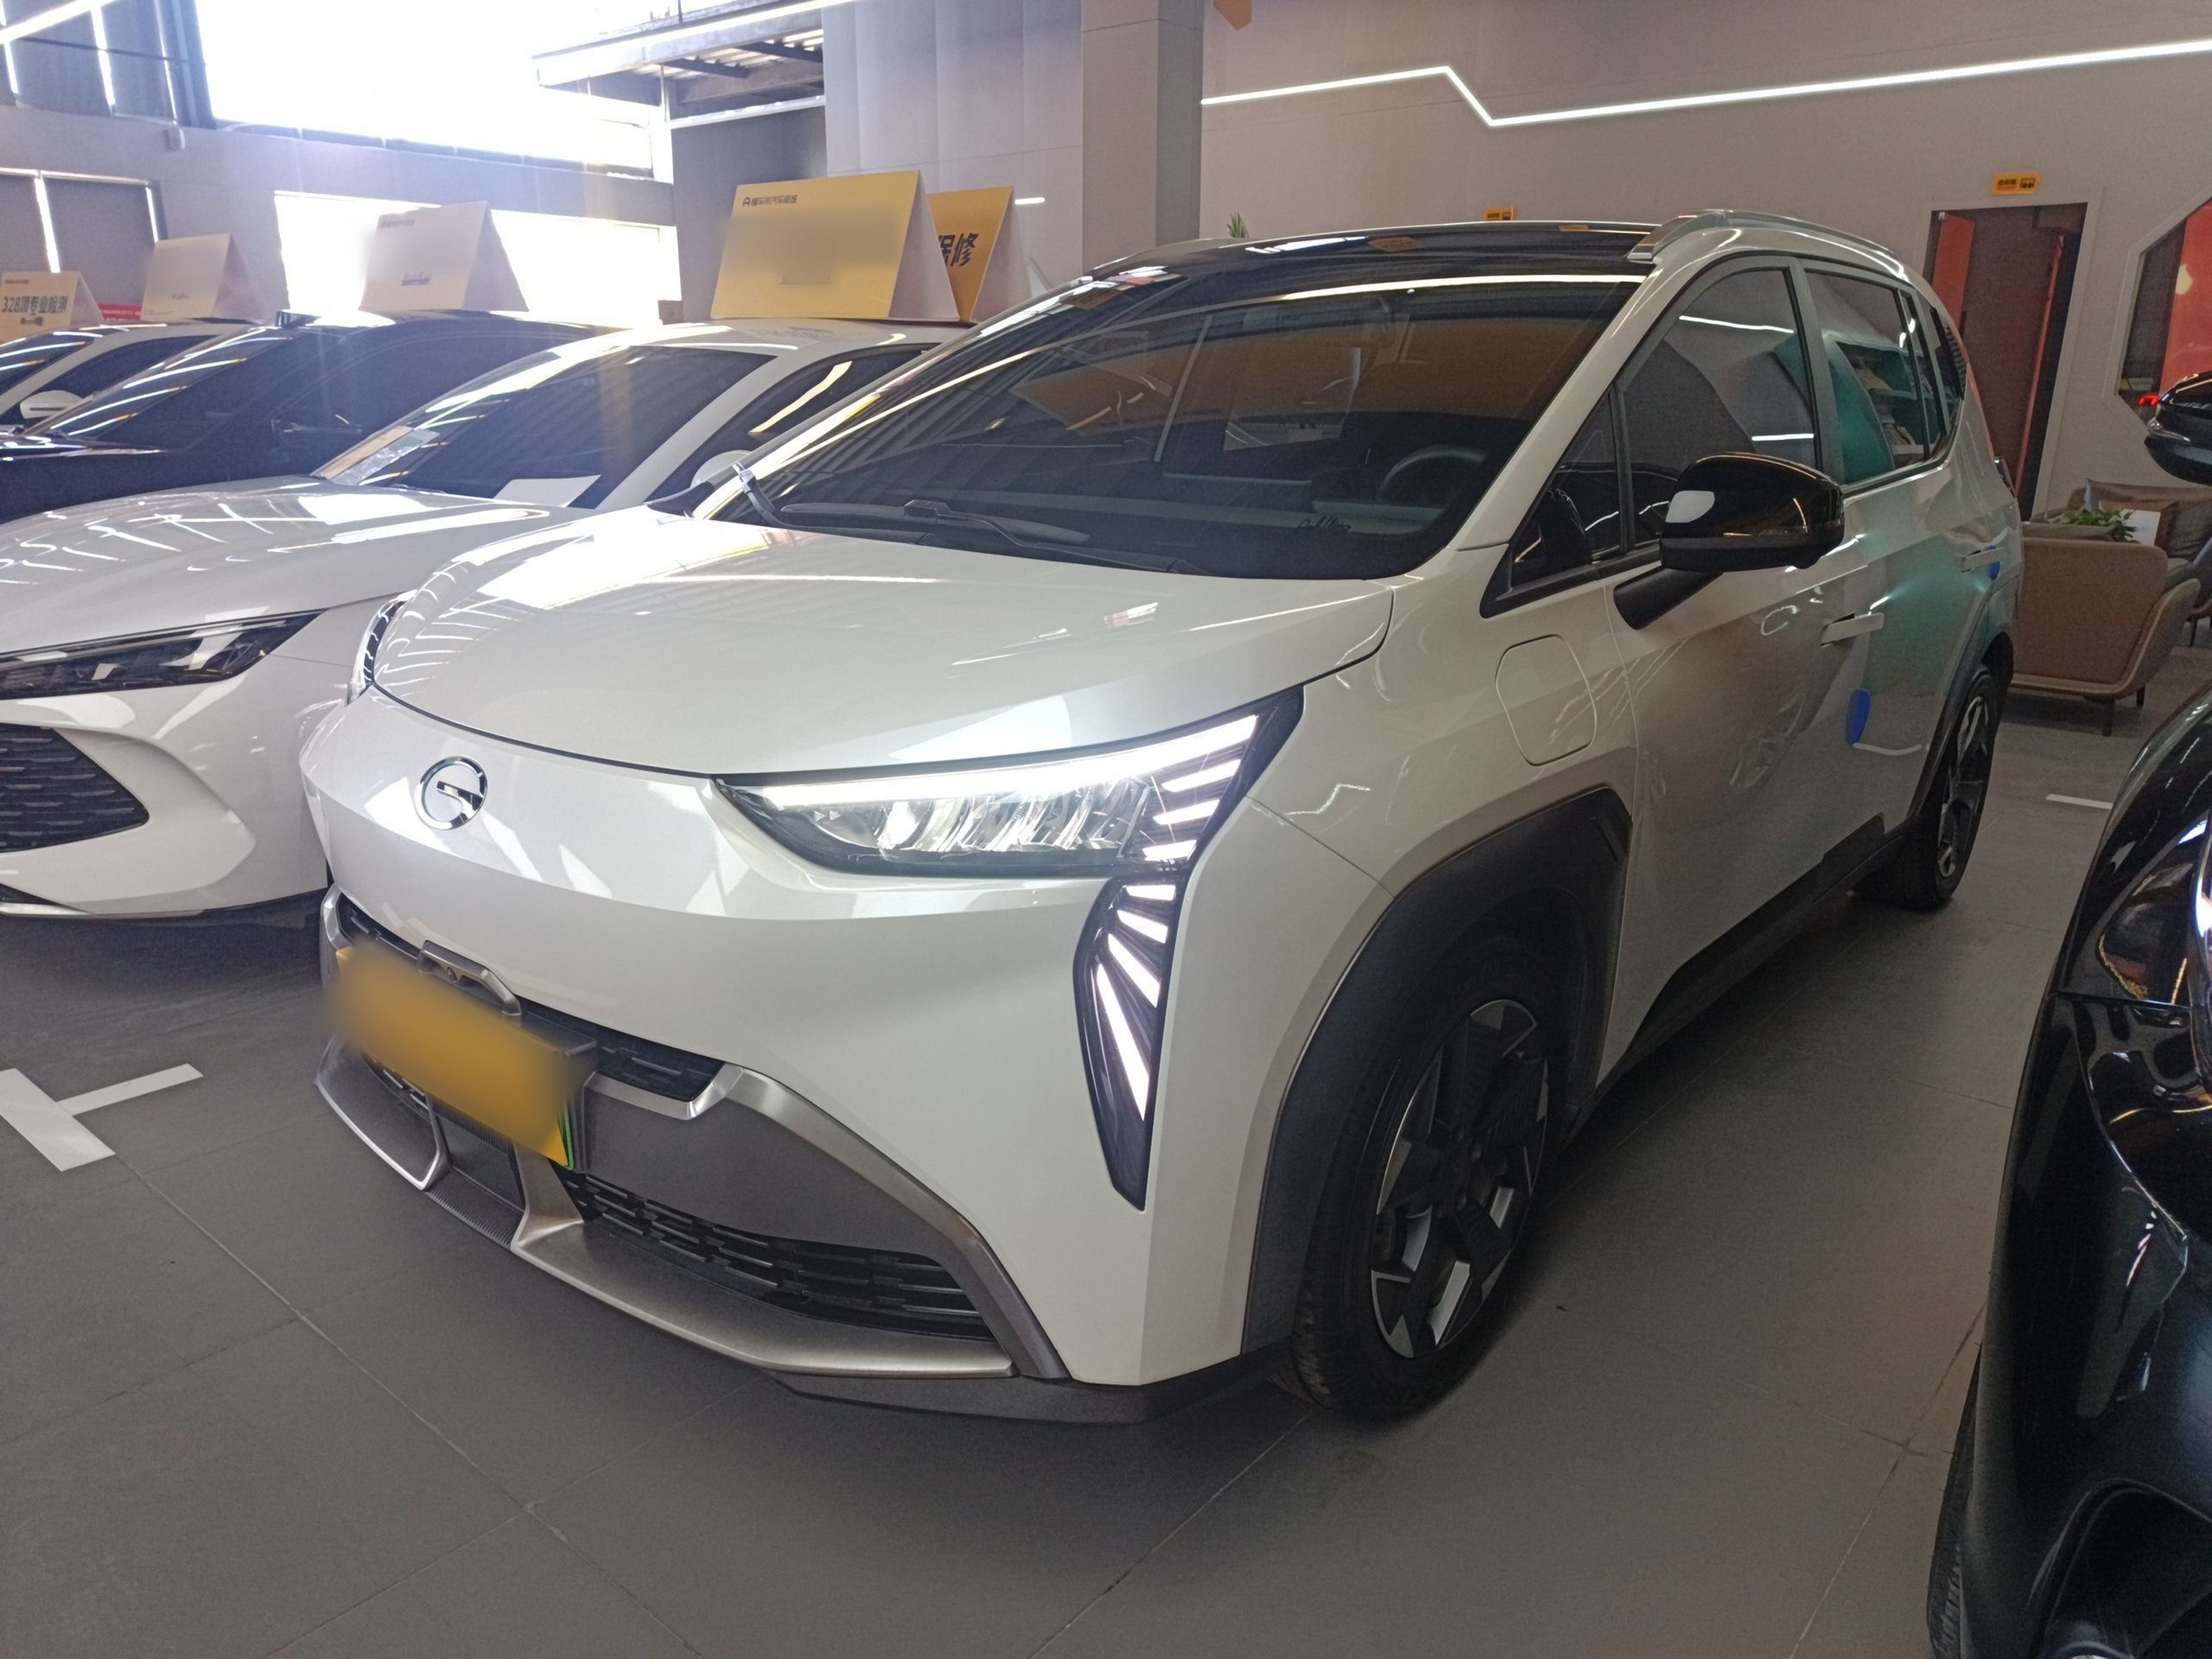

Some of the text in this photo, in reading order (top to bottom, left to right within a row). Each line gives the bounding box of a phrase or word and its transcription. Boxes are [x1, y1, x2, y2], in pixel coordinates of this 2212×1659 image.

[2, 296, 68, 315] 328项专业检测
